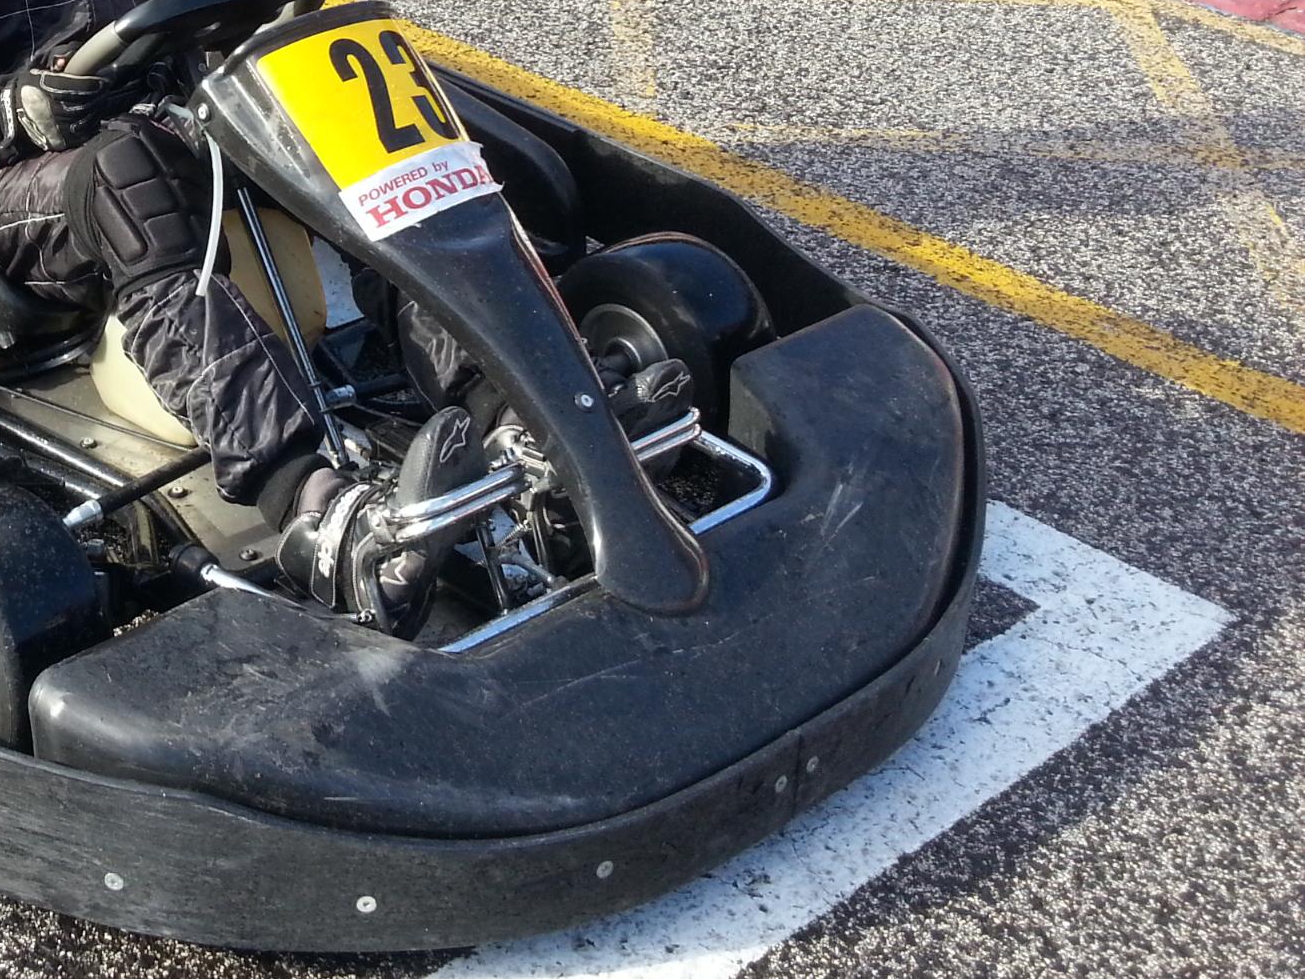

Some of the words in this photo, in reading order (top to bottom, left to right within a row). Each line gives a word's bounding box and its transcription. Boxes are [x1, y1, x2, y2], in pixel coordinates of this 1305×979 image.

[329, 29, 461, 154] 23
[358, 166, 428, 206] POWERED
[432, 160, 449, 173] by
[366, 164, 494, 228] HONDA
